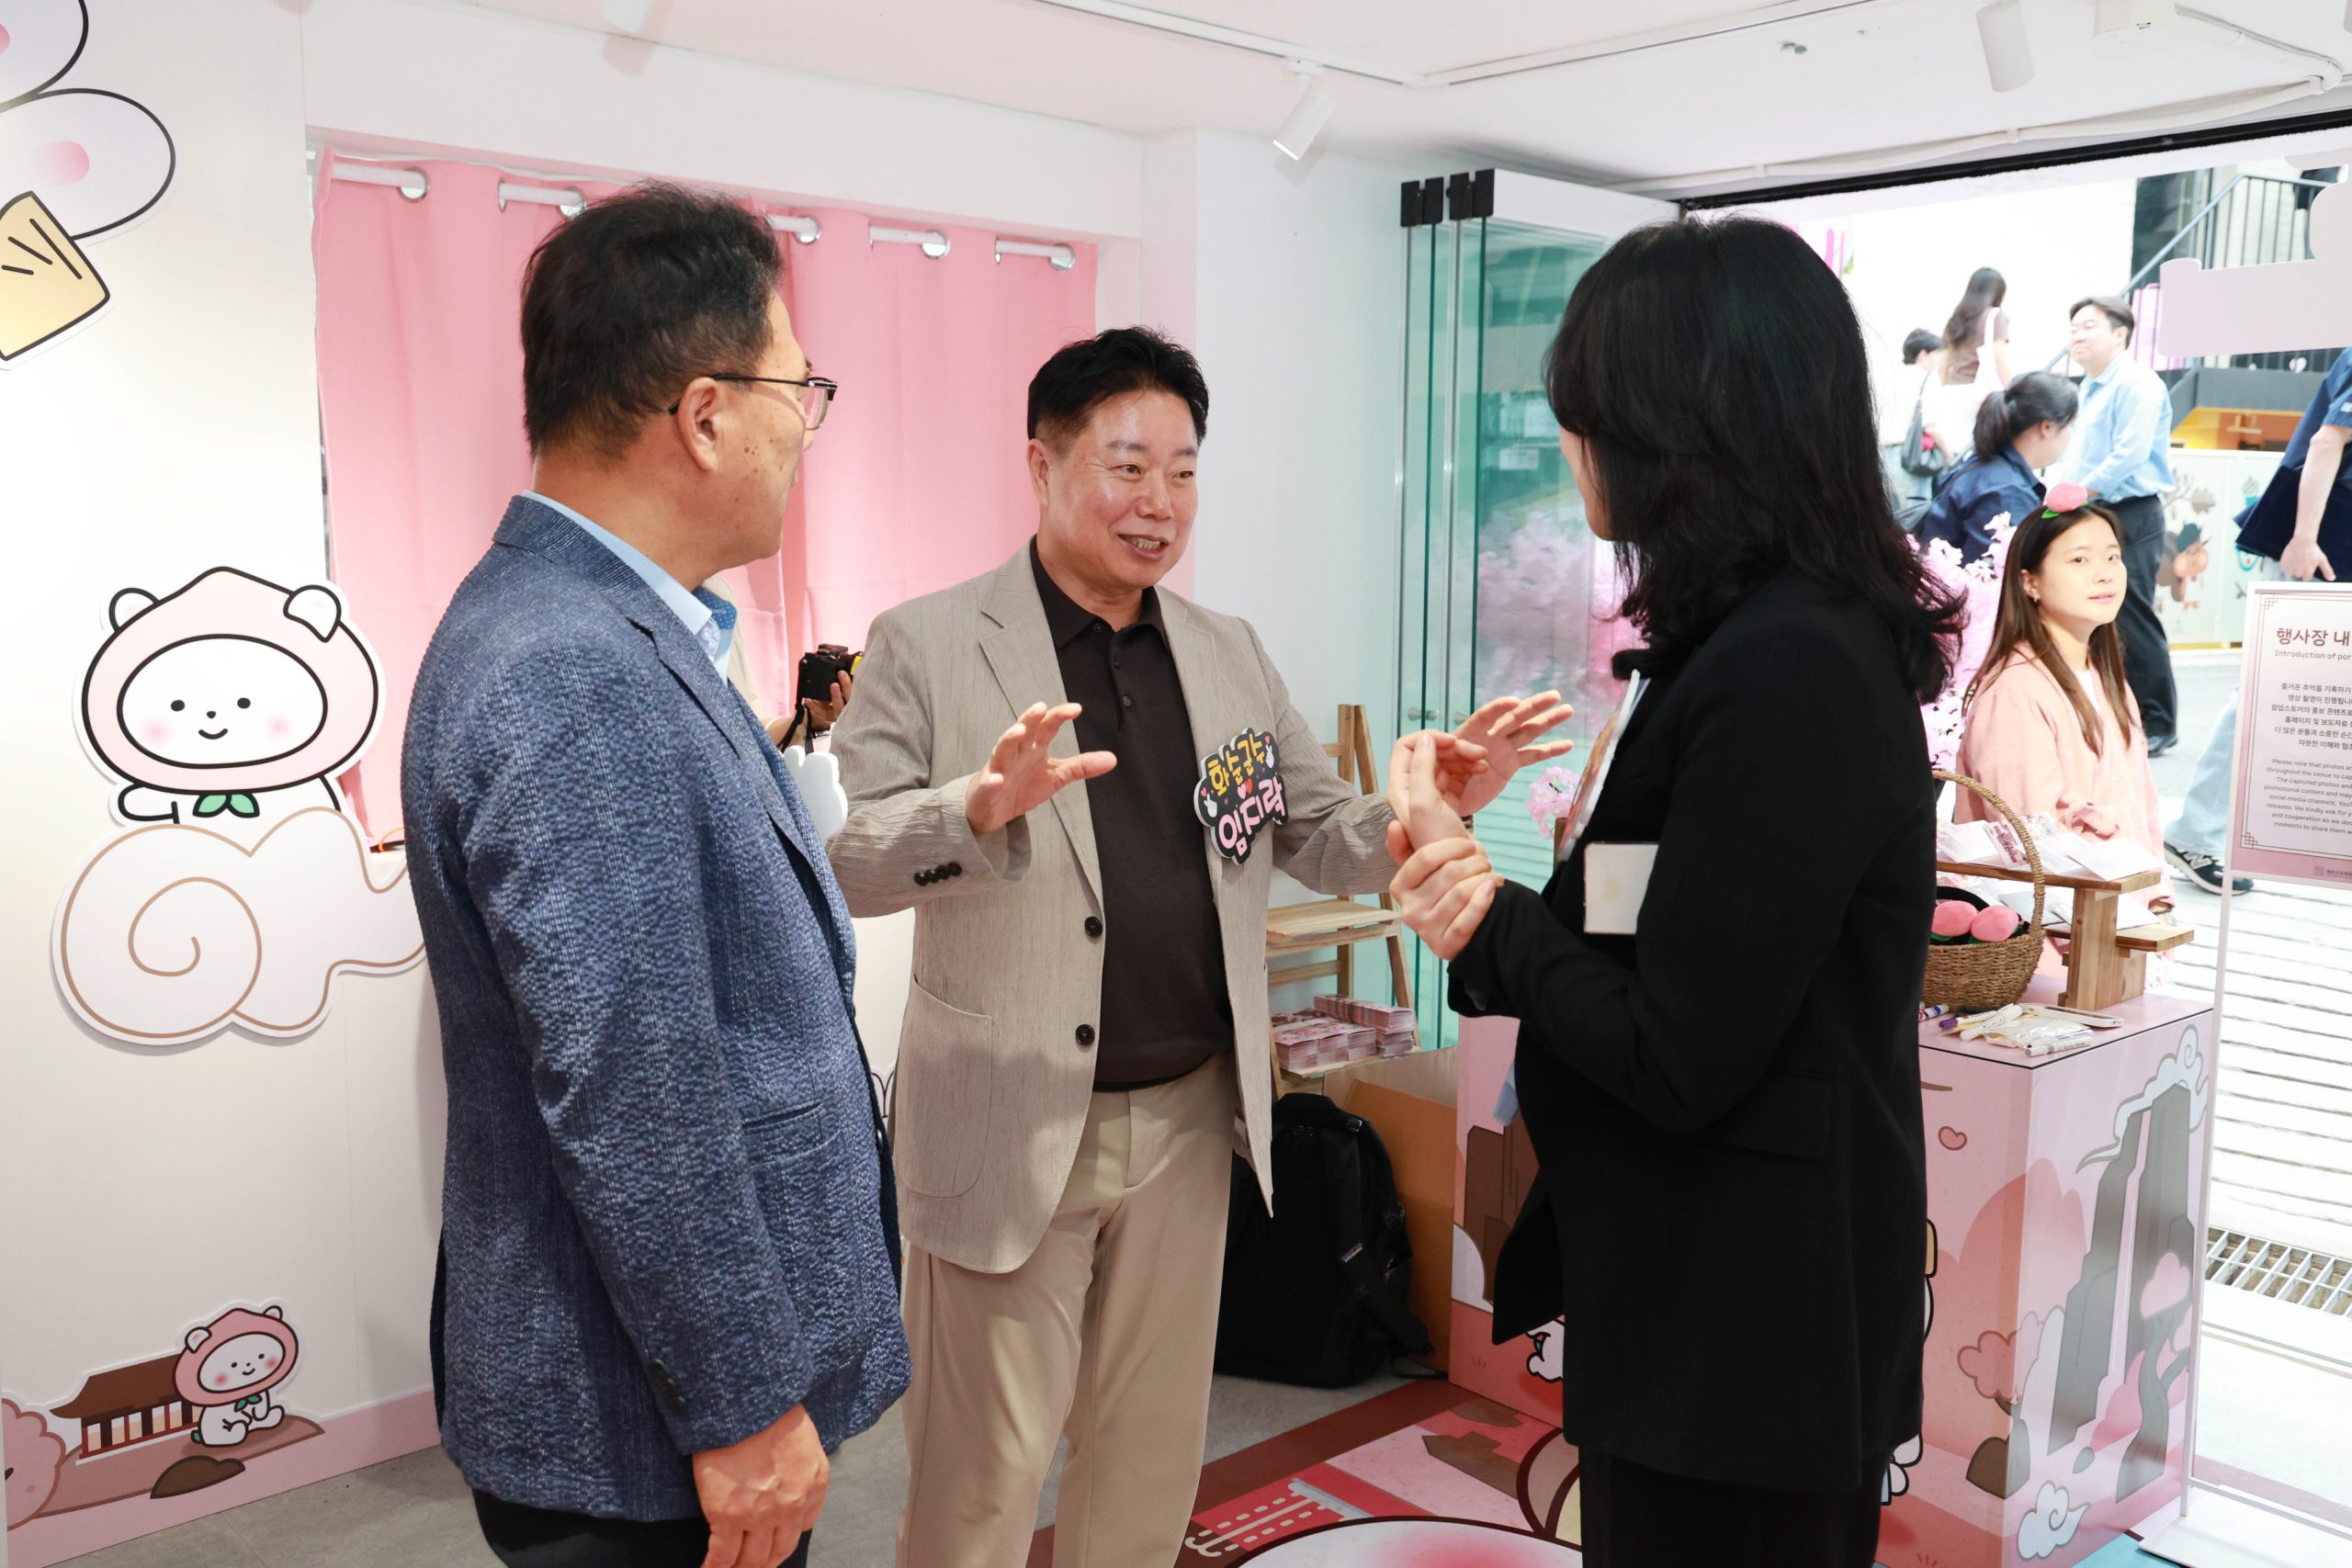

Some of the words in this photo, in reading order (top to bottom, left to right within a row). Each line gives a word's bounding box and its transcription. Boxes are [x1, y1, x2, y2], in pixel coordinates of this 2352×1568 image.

[2276, 627, 2328, 647] 행사장
[2334, 630, 2350, 647] 내
[2275, 649, 2325, 659] Introduction
[2302, 684, 2322, 693] 추억을
[2324, 685, 2351, 694] 기록하기
[2324, 696, 2352, 705] 진행됩니
[2271, 704, 2311, 713] 팝업스토어의
[2285, 716, 2312, 725] 홈페이지
[2319, 729, 2339, 738] 소중한
[2320, 740, 2340, 749] 이해와
[2317, 780, 2339, 788] photos
[2305, 806, 2324, 814] kindly
[1218, 775, 1286, 856] 임지락
